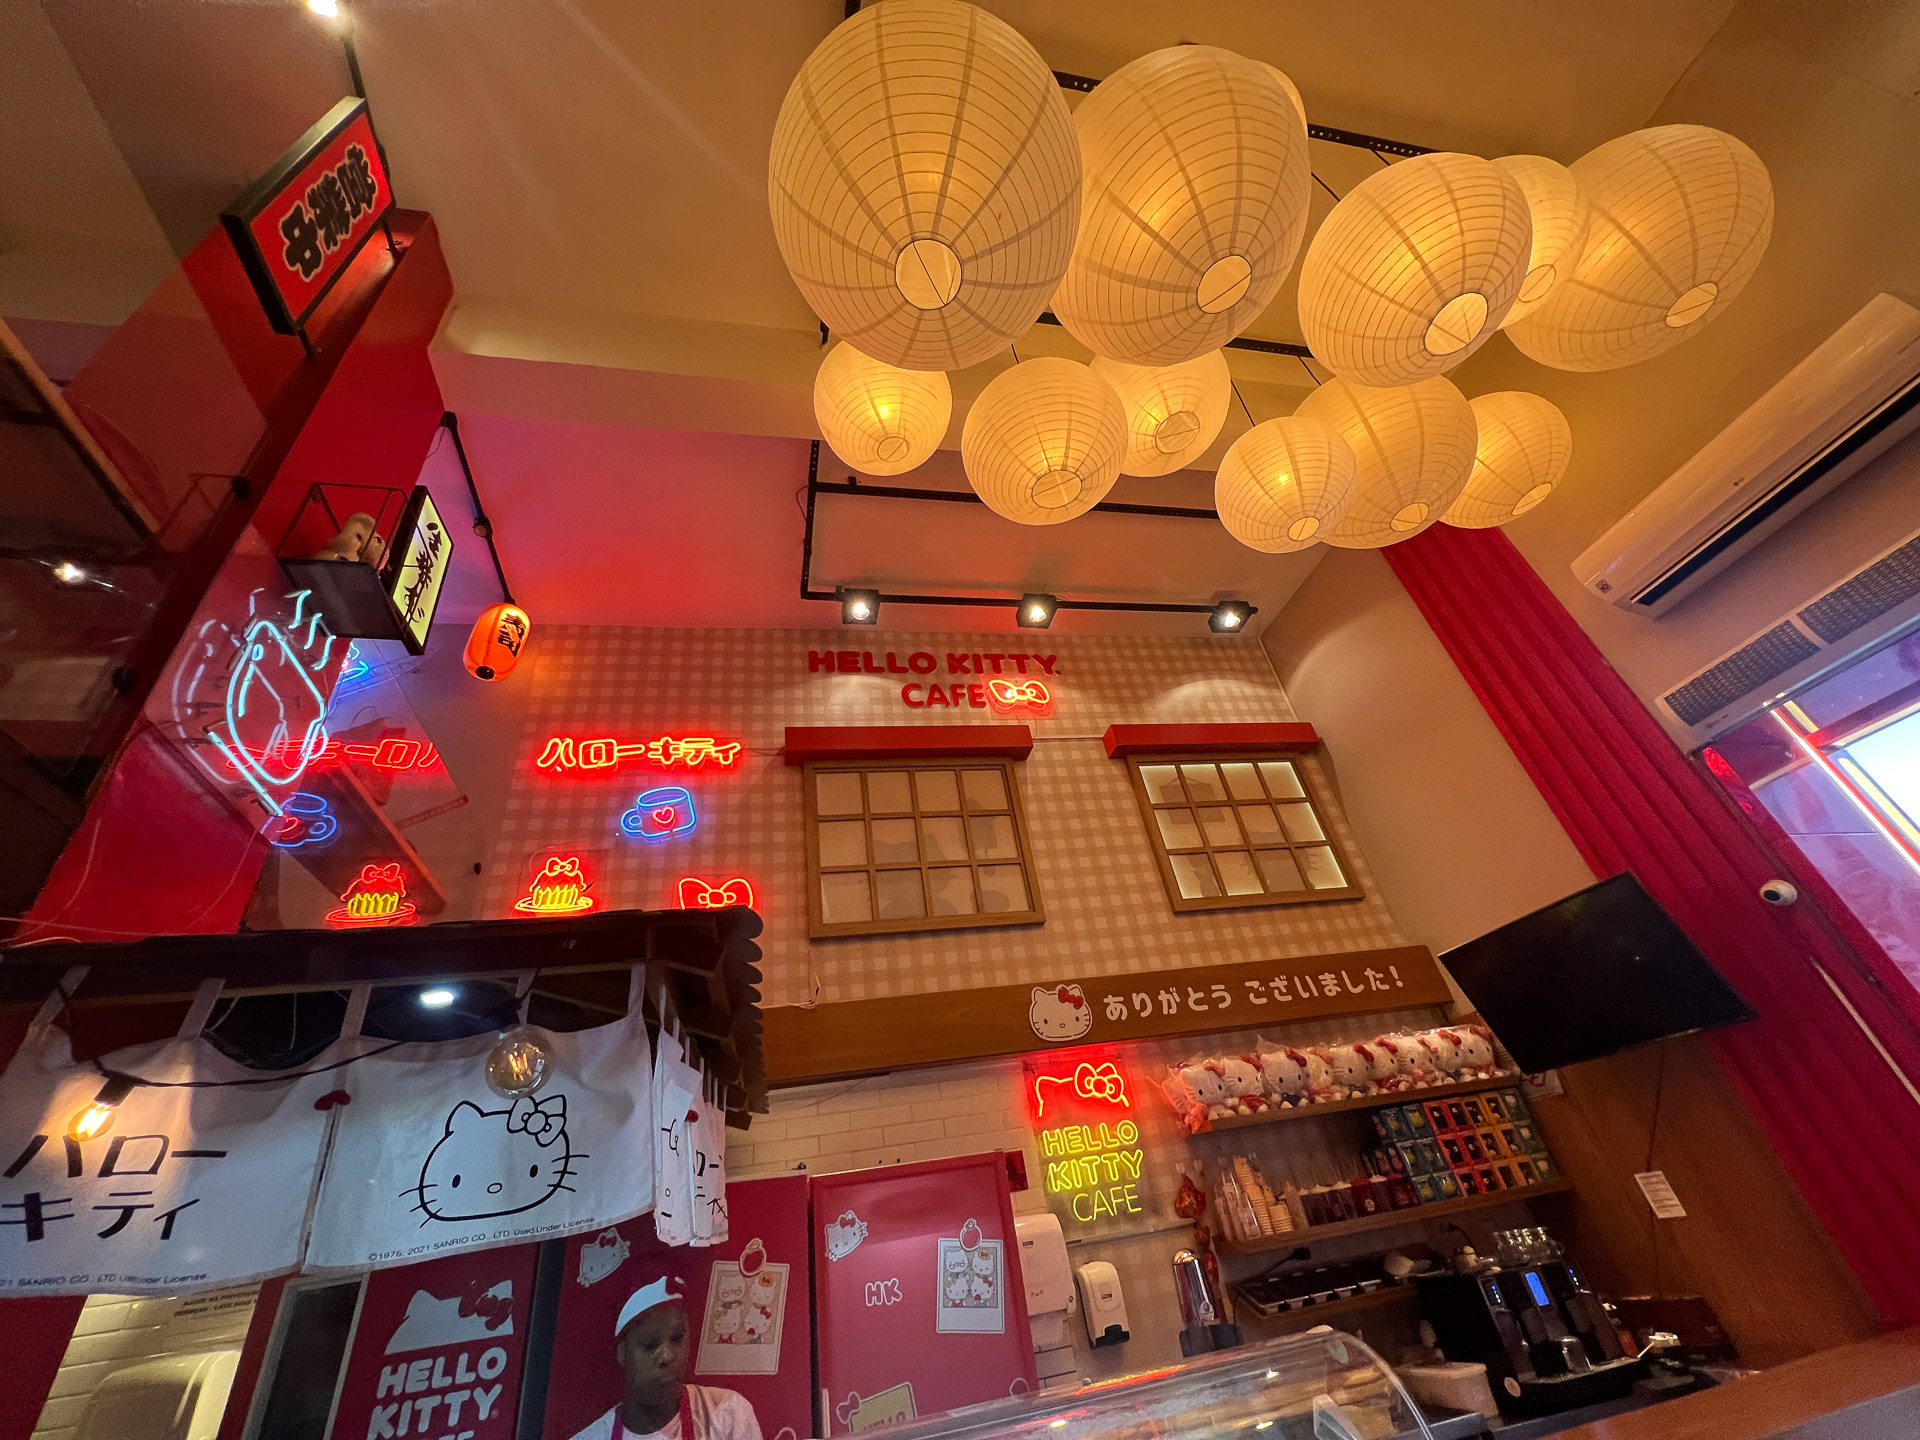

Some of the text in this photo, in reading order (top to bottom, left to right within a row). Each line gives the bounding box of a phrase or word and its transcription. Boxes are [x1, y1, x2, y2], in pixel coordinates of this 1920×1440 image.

[807, 650, 938, 675] HELLO
[900, 682, 987, 709] CAFE
[536, 736, 742, 769] ハローキティ
[1102, 983, 1233, 1022] ありがとう
[2, 1134, 228, 1179] ハロー
[1042, 1119, 1139, 1157] HELLO
[1048, 1149, 1144, 1193] KITTY
[0, 1190, 200, 1242] キティ
[1073, 1183, 1142, 1222] CAFE
[433, 1236, 469, 1250] SANRIO
[535, 1223, 561, 1234] Under
[865, 1277, 903, 1307] HK
[376, 1346, 508, 1399] HELLO
[366, 1383, 503, 1440] KITTY
